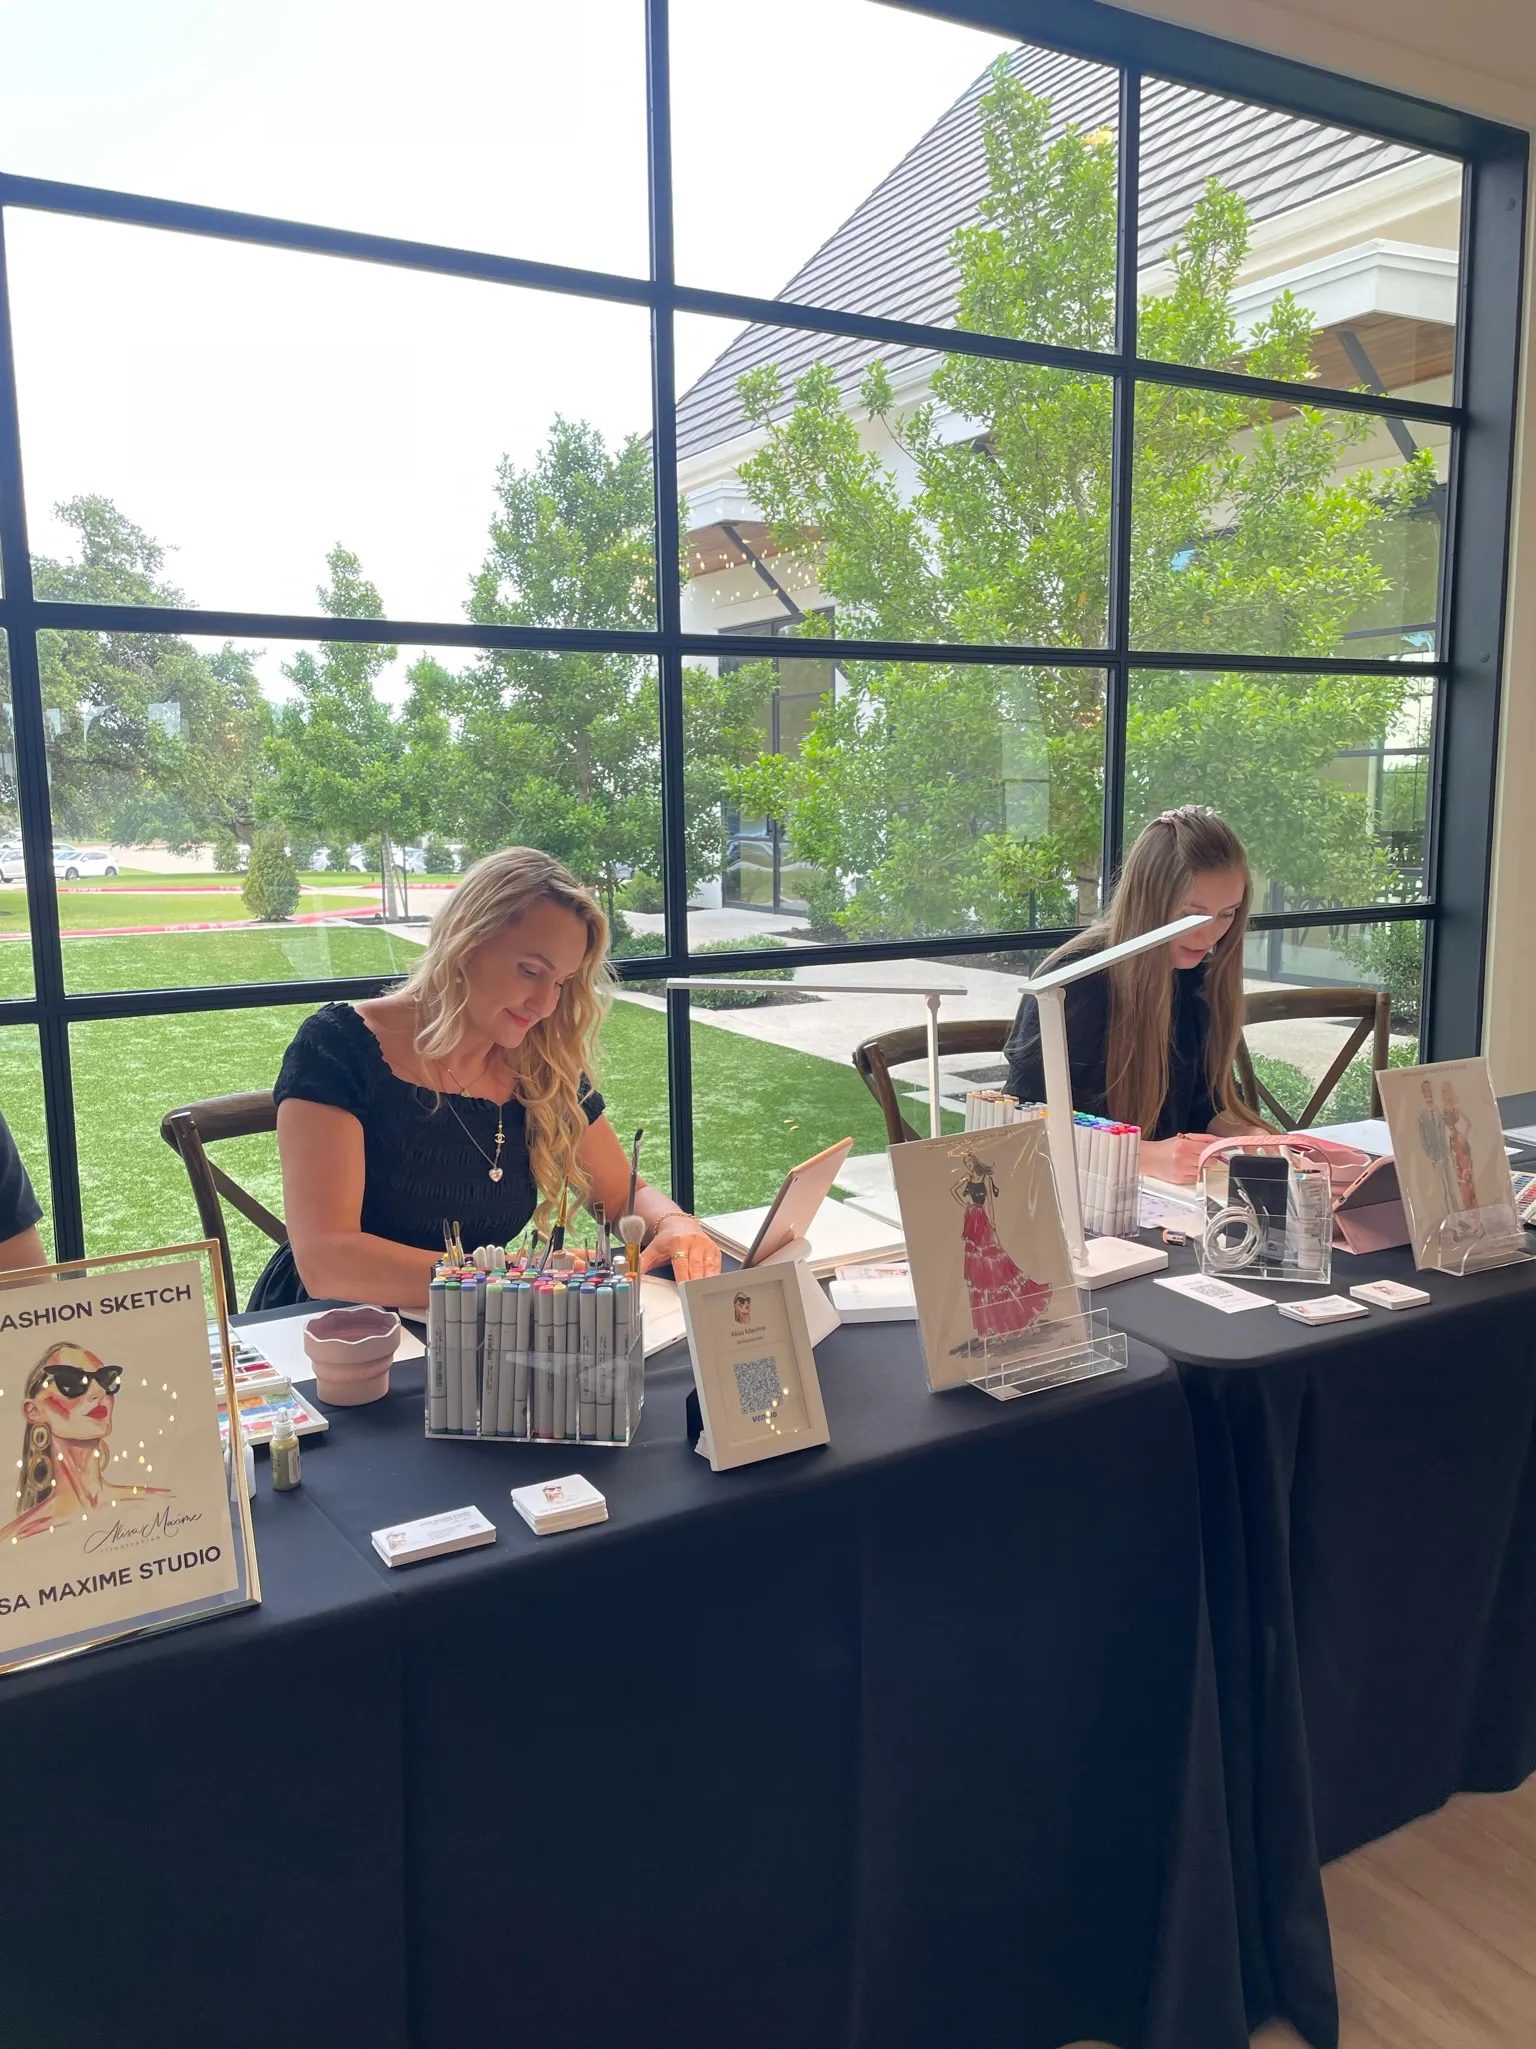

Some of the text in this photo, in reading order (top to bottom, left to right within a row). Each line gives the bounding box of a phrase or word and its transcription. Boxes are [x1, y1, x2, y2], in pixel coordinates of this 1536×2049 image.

[100, 1284, 192, 1315] SKETCH
[38, 1567, 133, 1606] MAXIME
[139, 1545, 222, 1580] STUDIO
